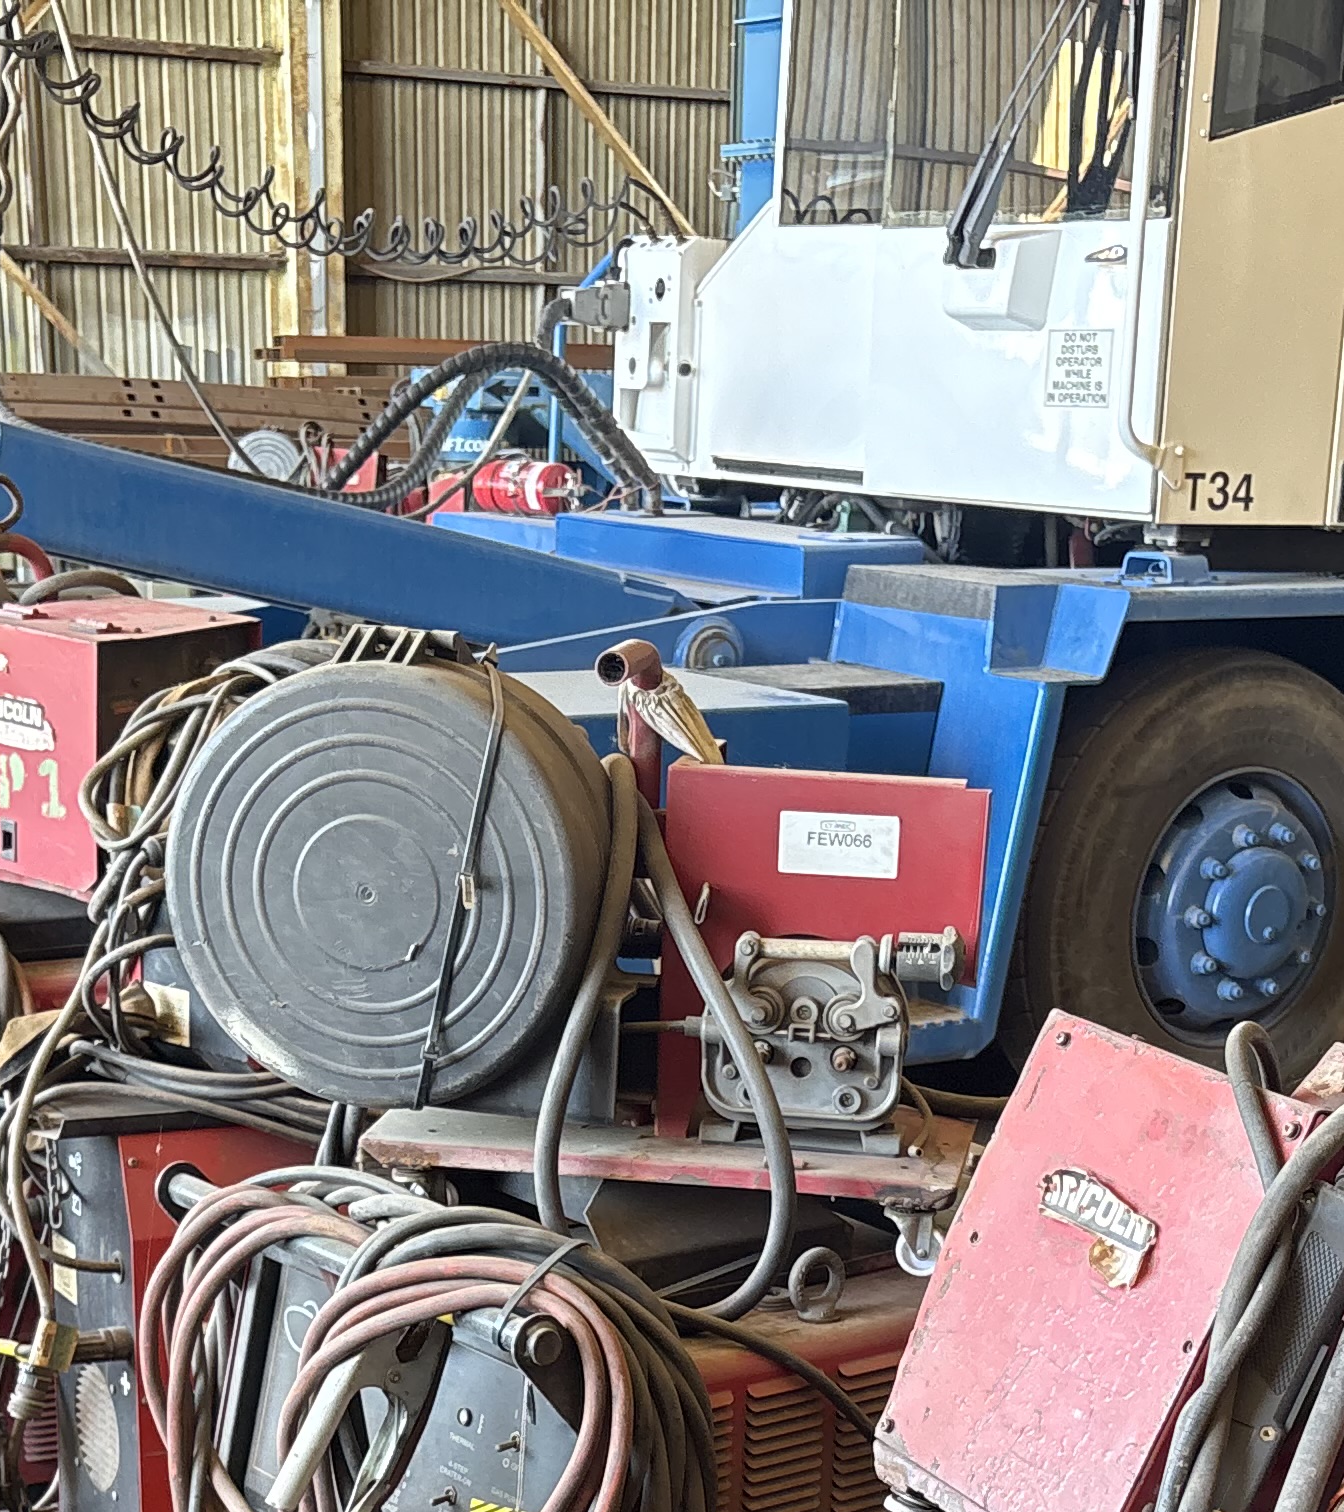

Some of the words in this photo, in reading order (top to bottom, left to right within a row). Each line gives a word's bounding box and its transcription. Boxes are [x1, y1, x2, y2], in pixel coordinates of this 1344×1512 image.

[1064, 333, 1076, 343] DO
[1080, 332, 1098, 343] NOT
[1061, 345, 1098, 355] DISTURB
[1056, 357, 1102, 367] OPERATOR
[1065, 369, 1091, 379] WHILE
[1053, 381, 1091, 391] MACHINE
[1095, 381, 1103, 391] IS
[1047, 393, 1055, 402] IN
[1058, 393, 1107, 403] OPERATION
[1185, 471, 1255, 513] T34
[807, 831, 872, 848] FEW066
